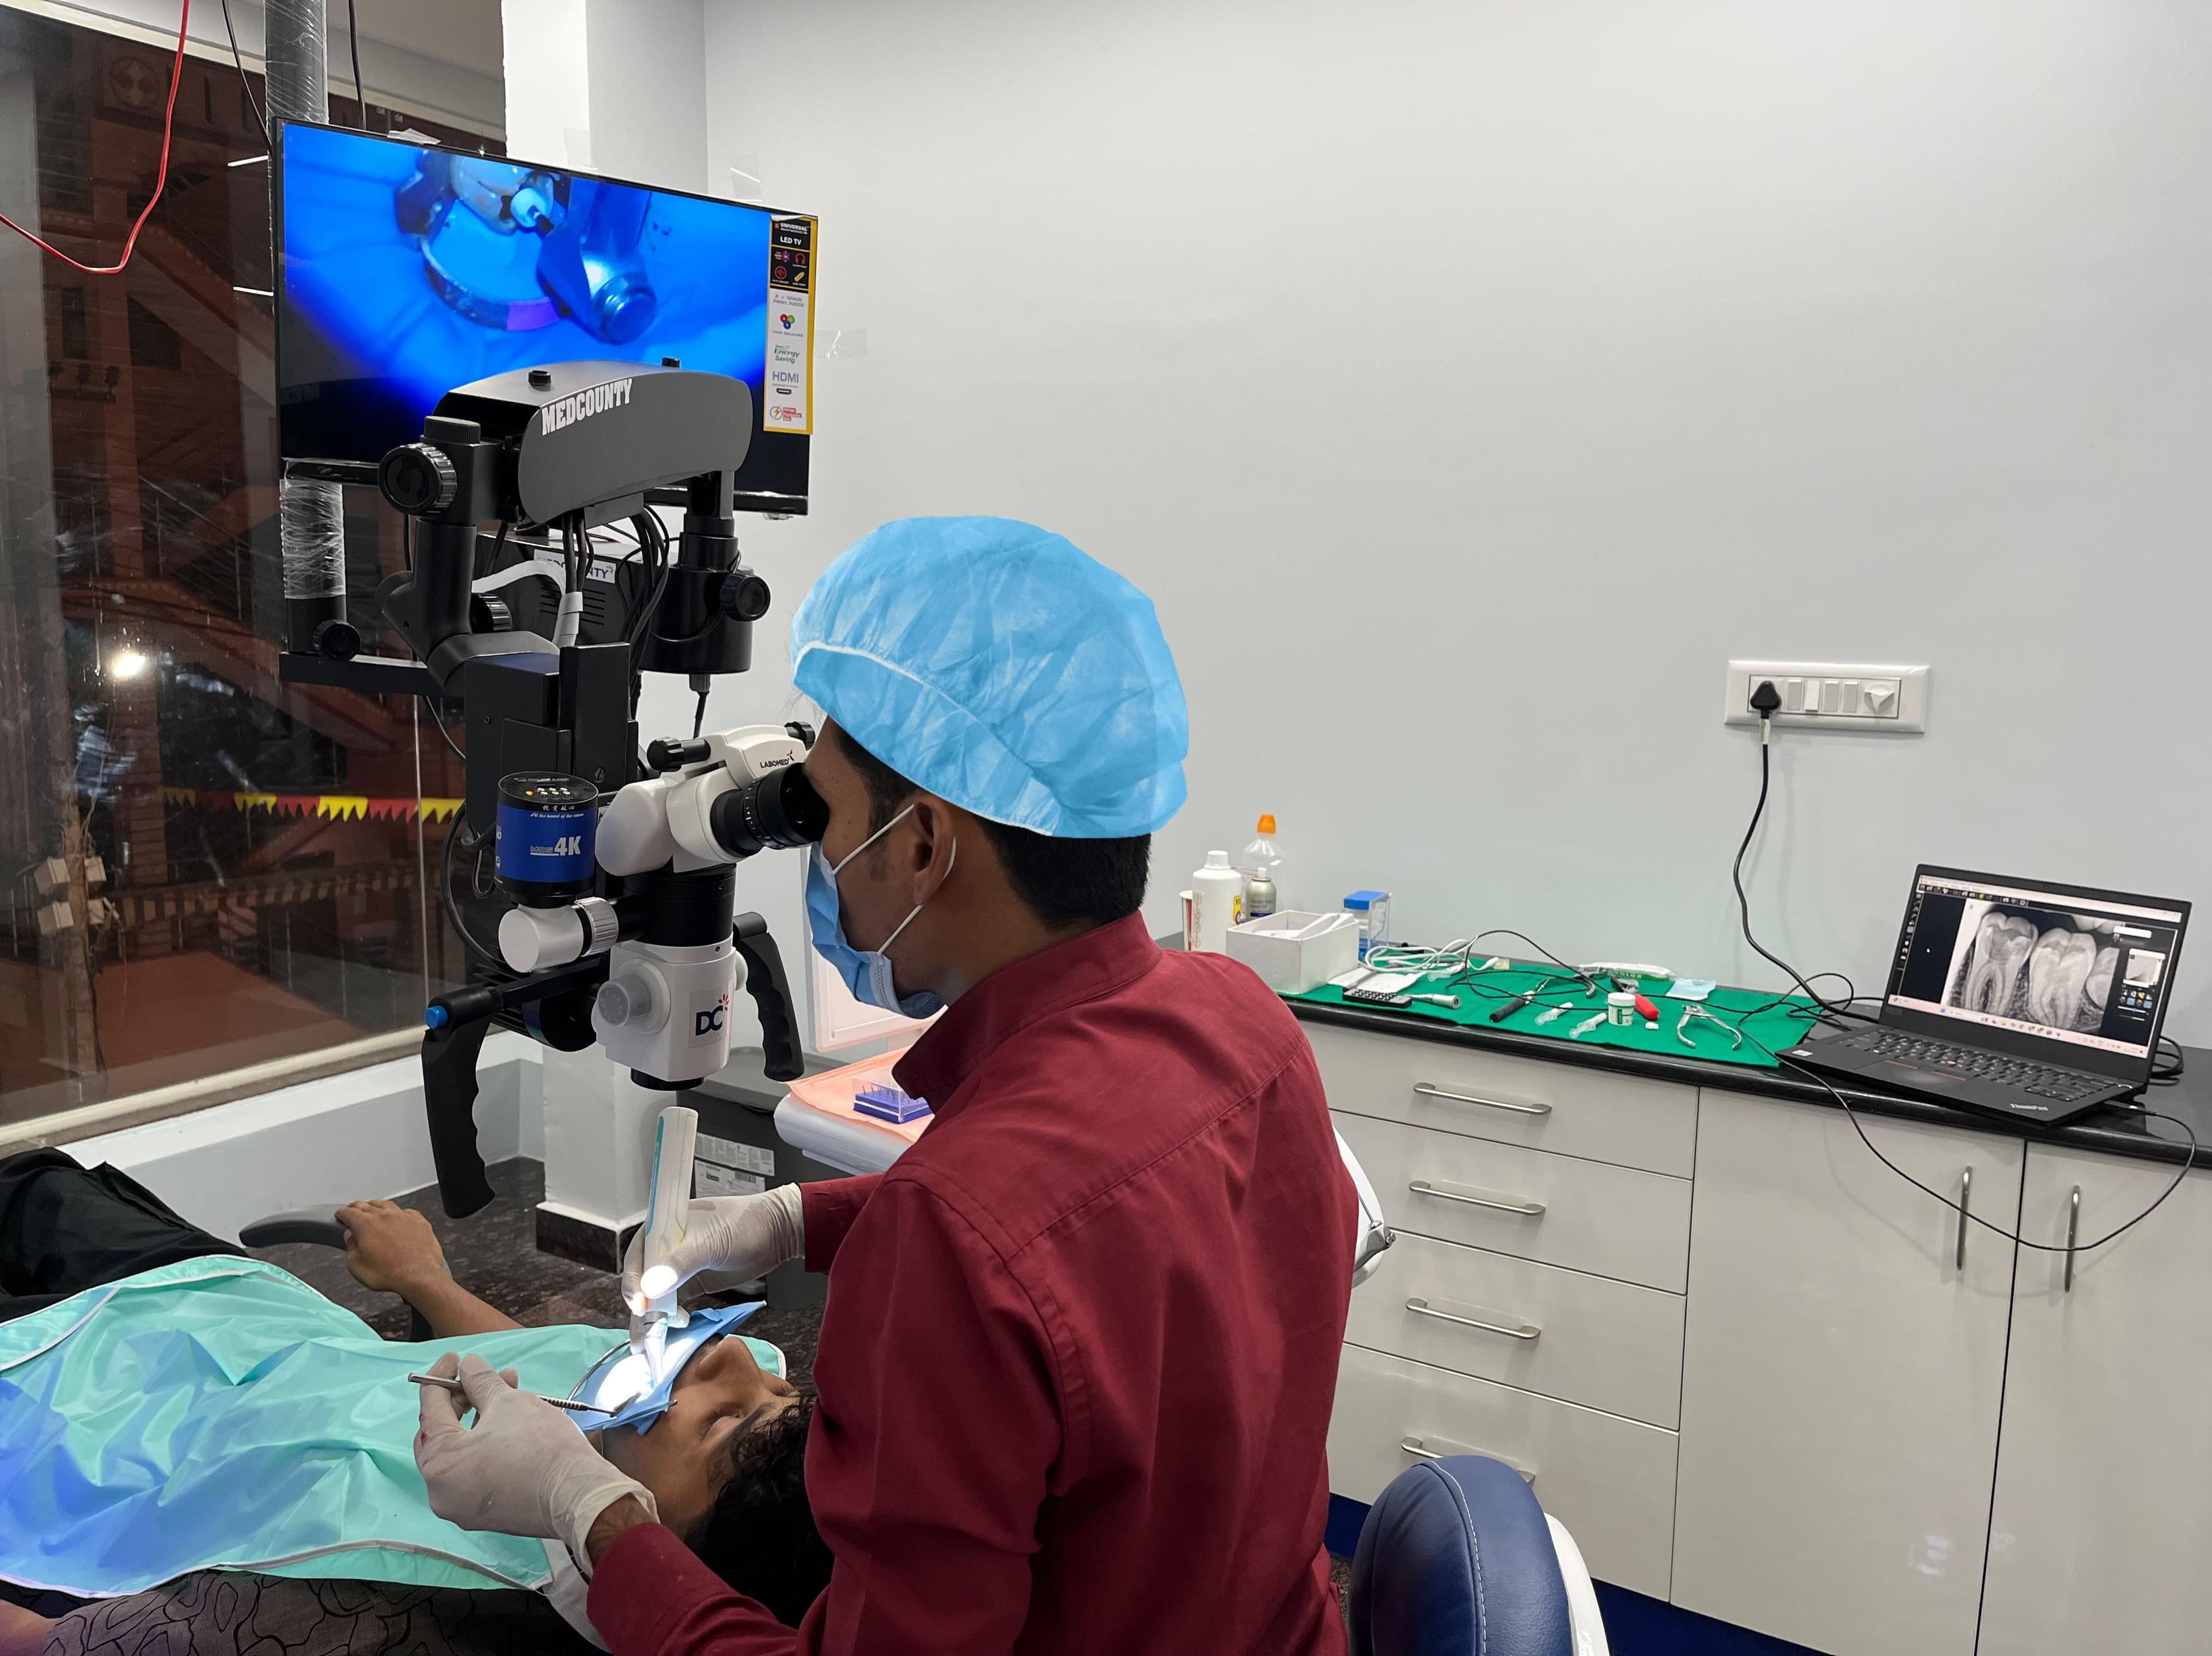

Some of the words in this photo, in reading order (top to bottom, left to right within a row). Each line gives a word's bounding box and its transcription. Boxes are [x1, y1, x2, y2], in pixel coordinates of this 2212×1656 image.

[780, 222, 808, 232] UNIVERSAL
[780, 236, 793, 244] LED
[794, 237, 802, 245] TV
[774, 348, 800, 358] Energy
[775, 355, 795, 364] Saving
[772, 370, 799, 383] HDMI
[541, 378, 632, 436] MEDCOUNTY
[760, 759, 789, 768] LABOMED
[695, 1005, 724, 1036] DC
